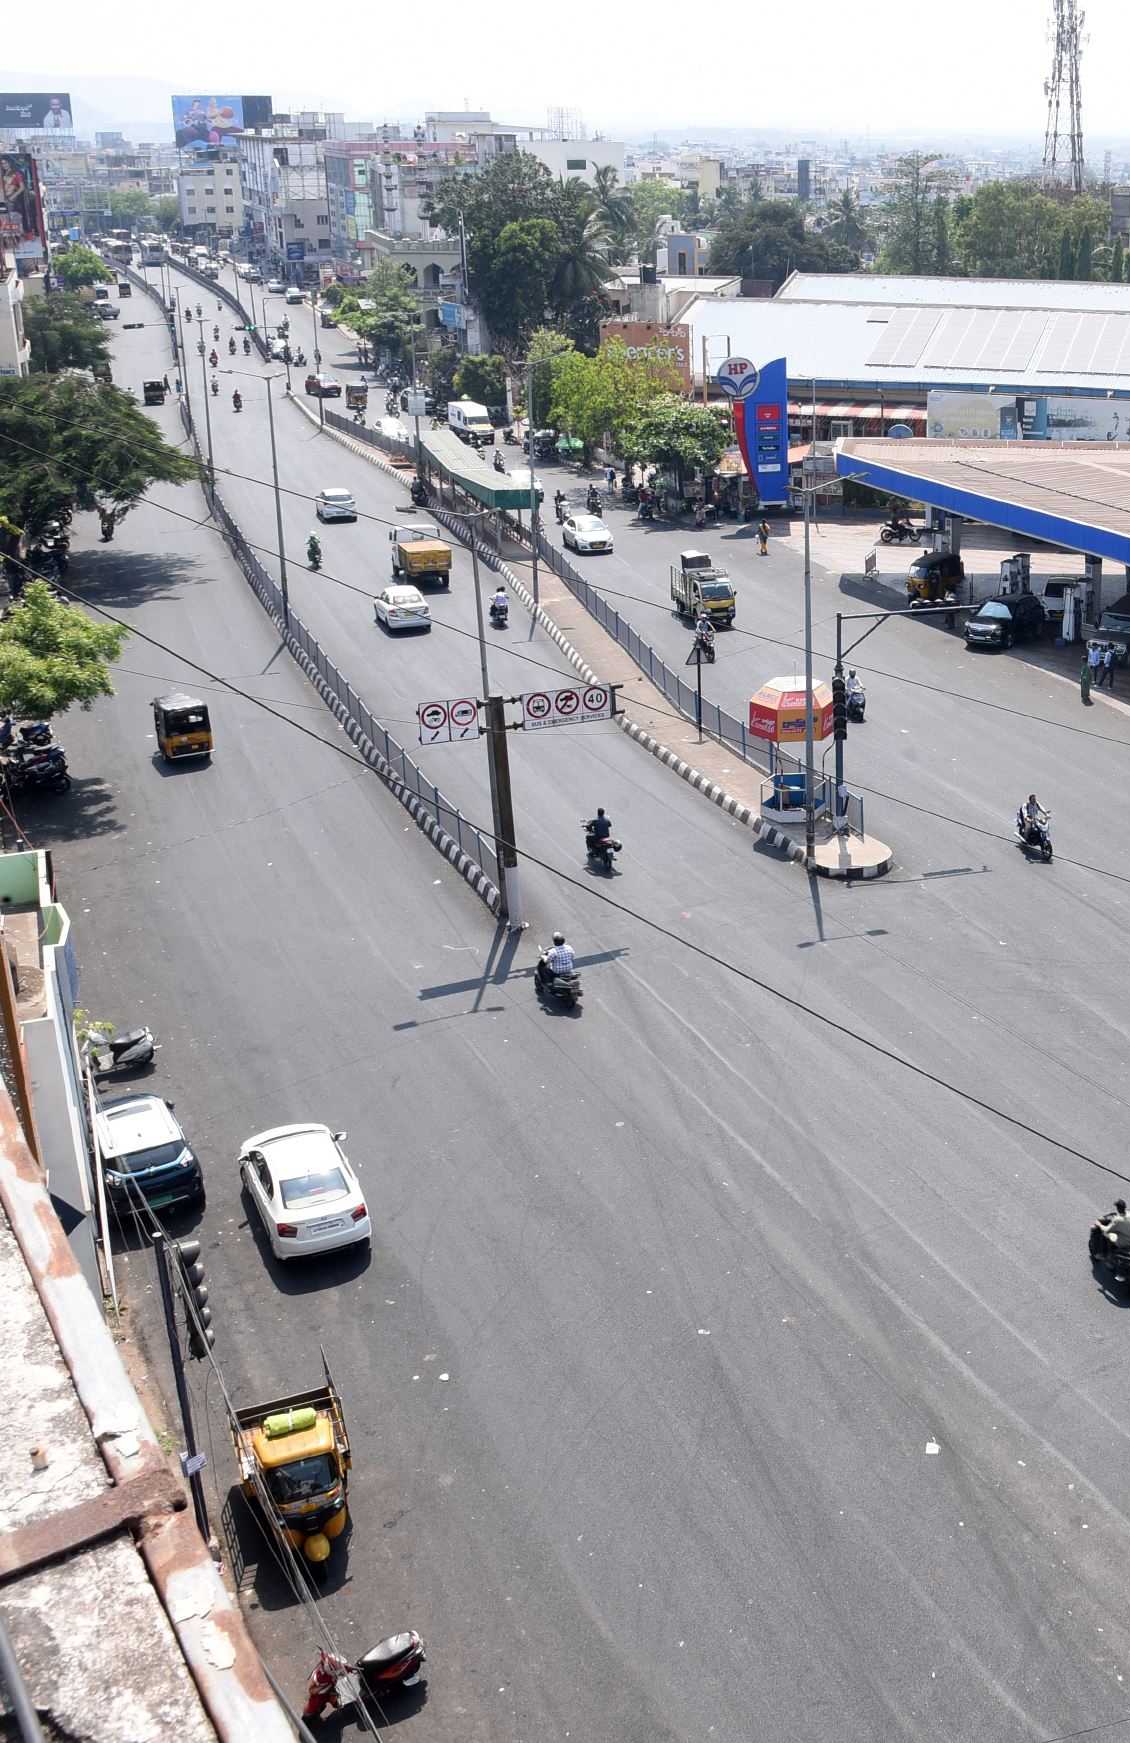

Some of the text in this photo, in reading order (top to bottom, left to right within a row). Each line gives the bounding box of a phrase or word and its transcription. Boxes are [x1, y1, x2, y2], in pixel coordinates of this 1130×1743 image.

[728, 362, 748, 375] HP
[587, 693, 603, 704] 40
[547, 716, 580, 726] EMERGENCY
[580, 712, 605, 721] SERVICES
